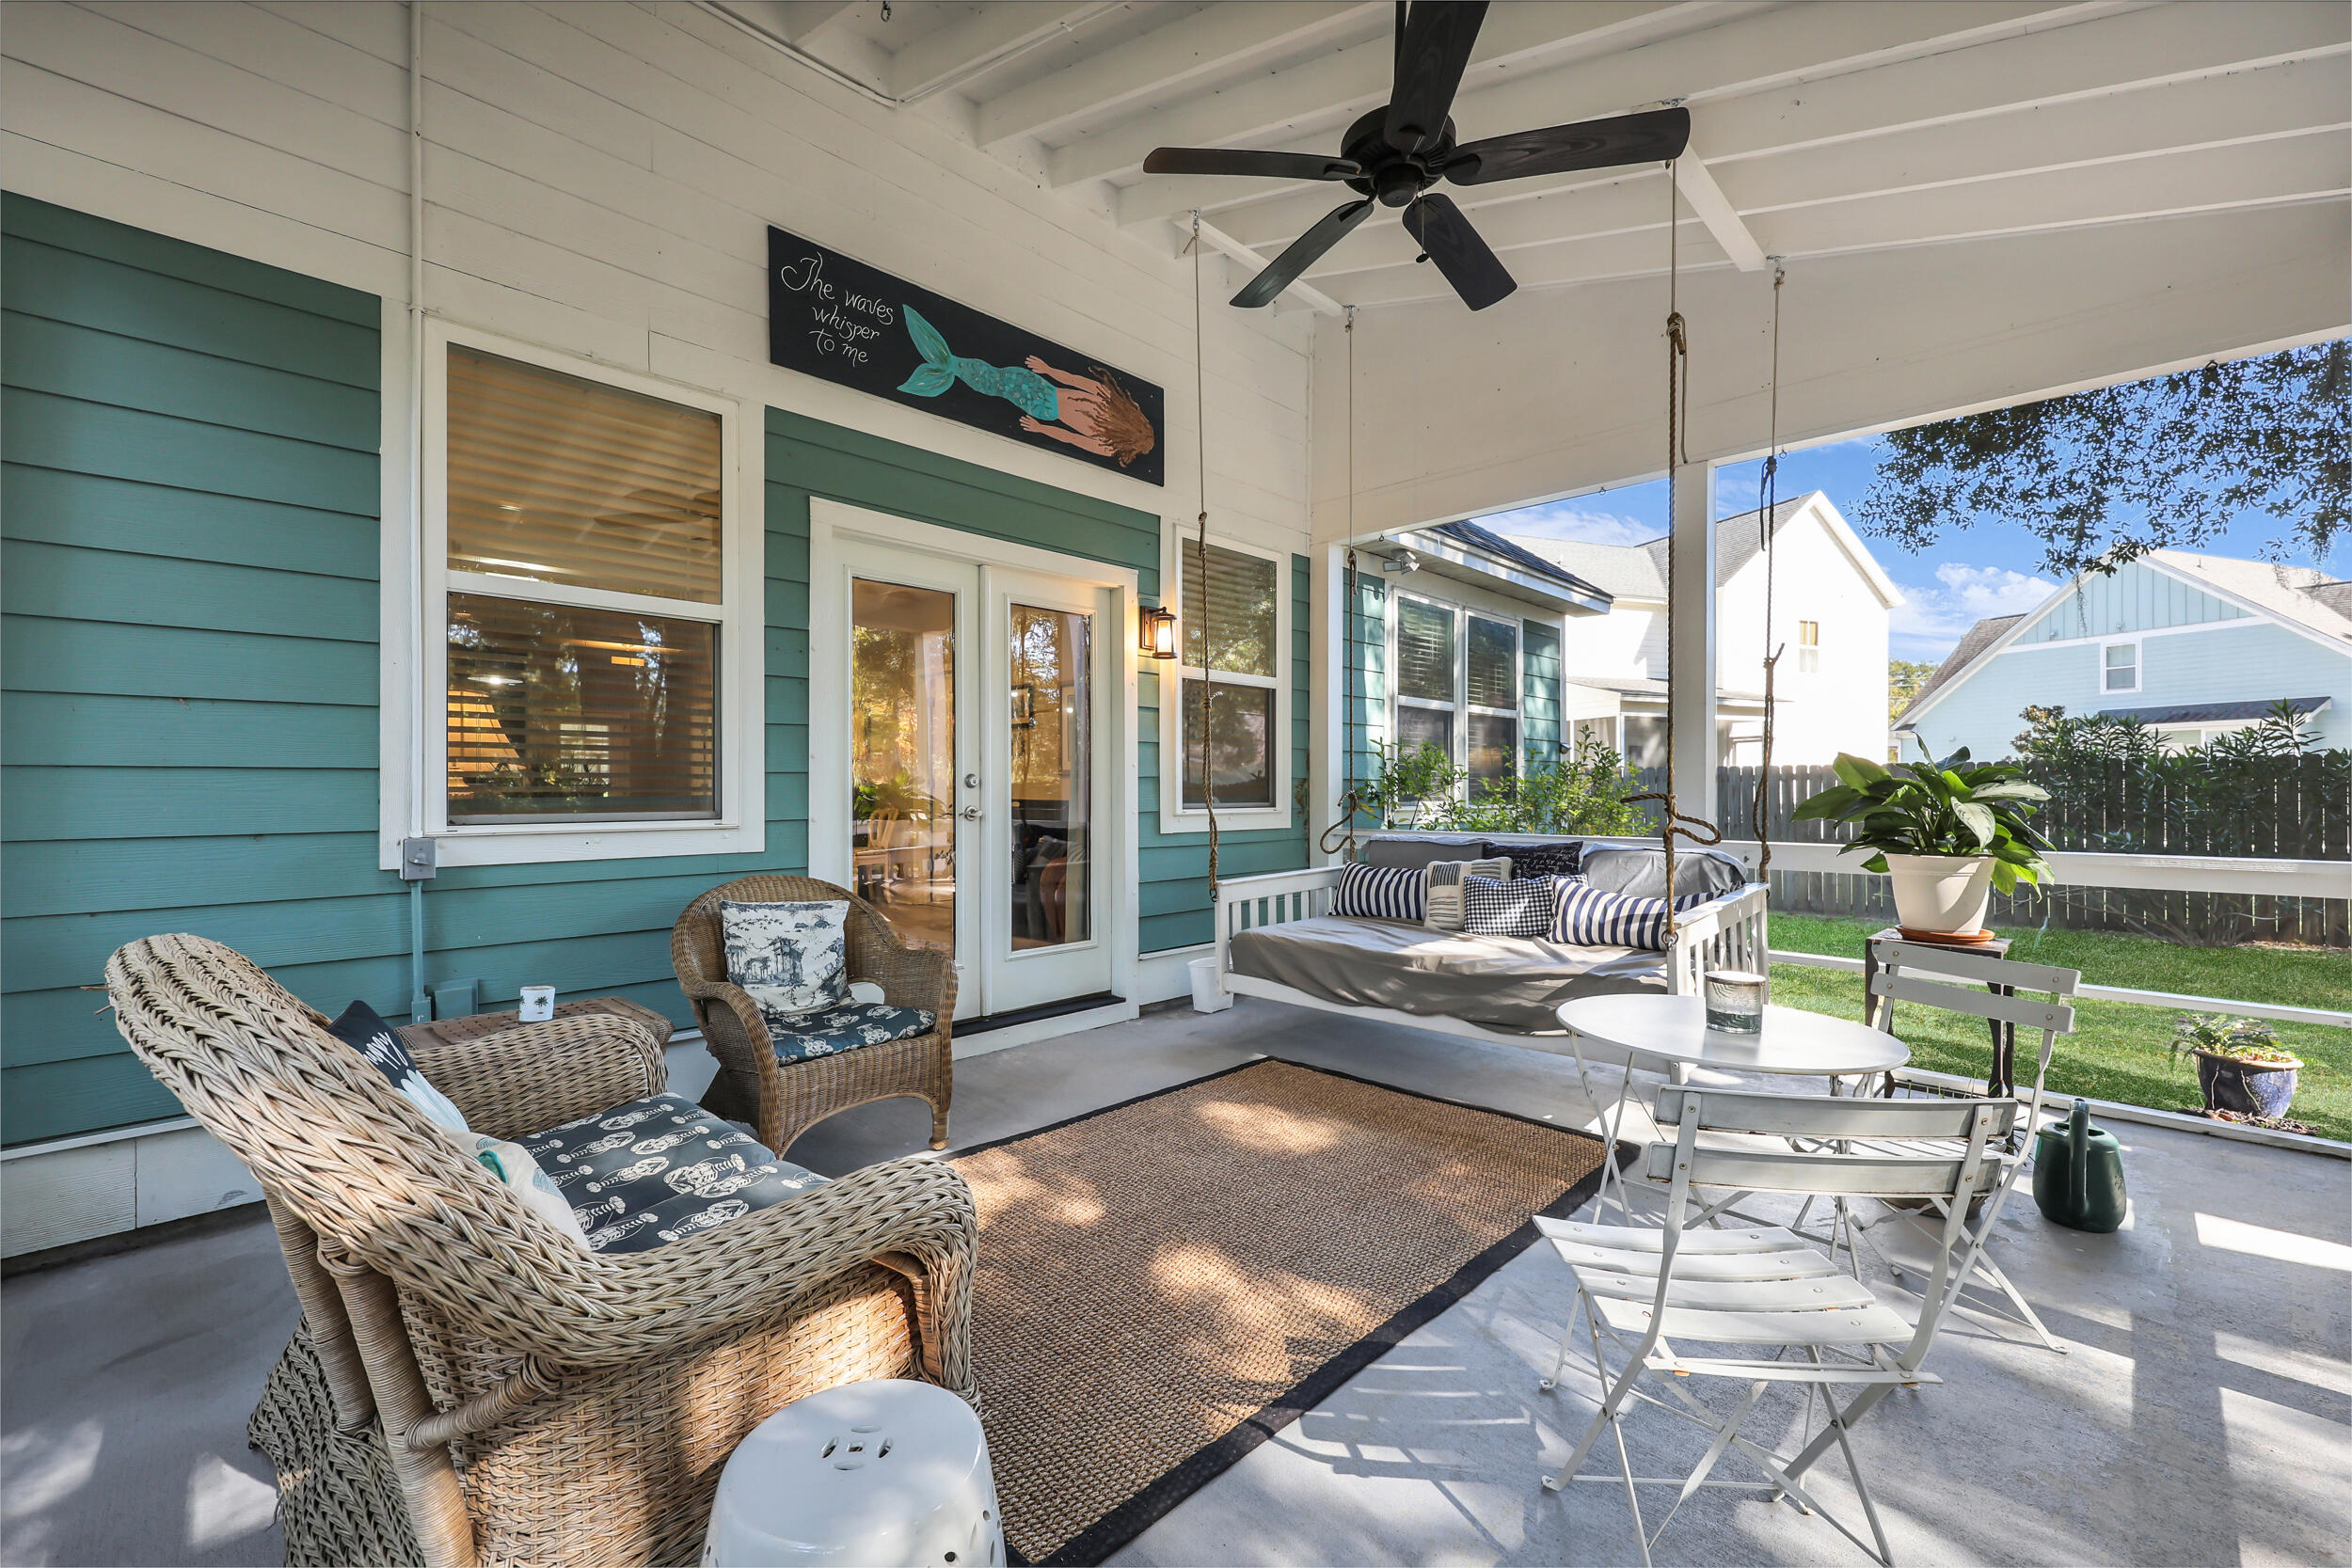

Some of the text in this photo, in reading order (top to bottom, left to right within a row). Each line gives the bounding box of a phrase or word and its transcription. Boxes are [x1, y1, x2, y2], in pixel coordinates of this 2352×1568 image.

[781, 251, 894, 325] The waves
[812, 305, 881, 342] whisper
[808, 328, 868, 368] to me
